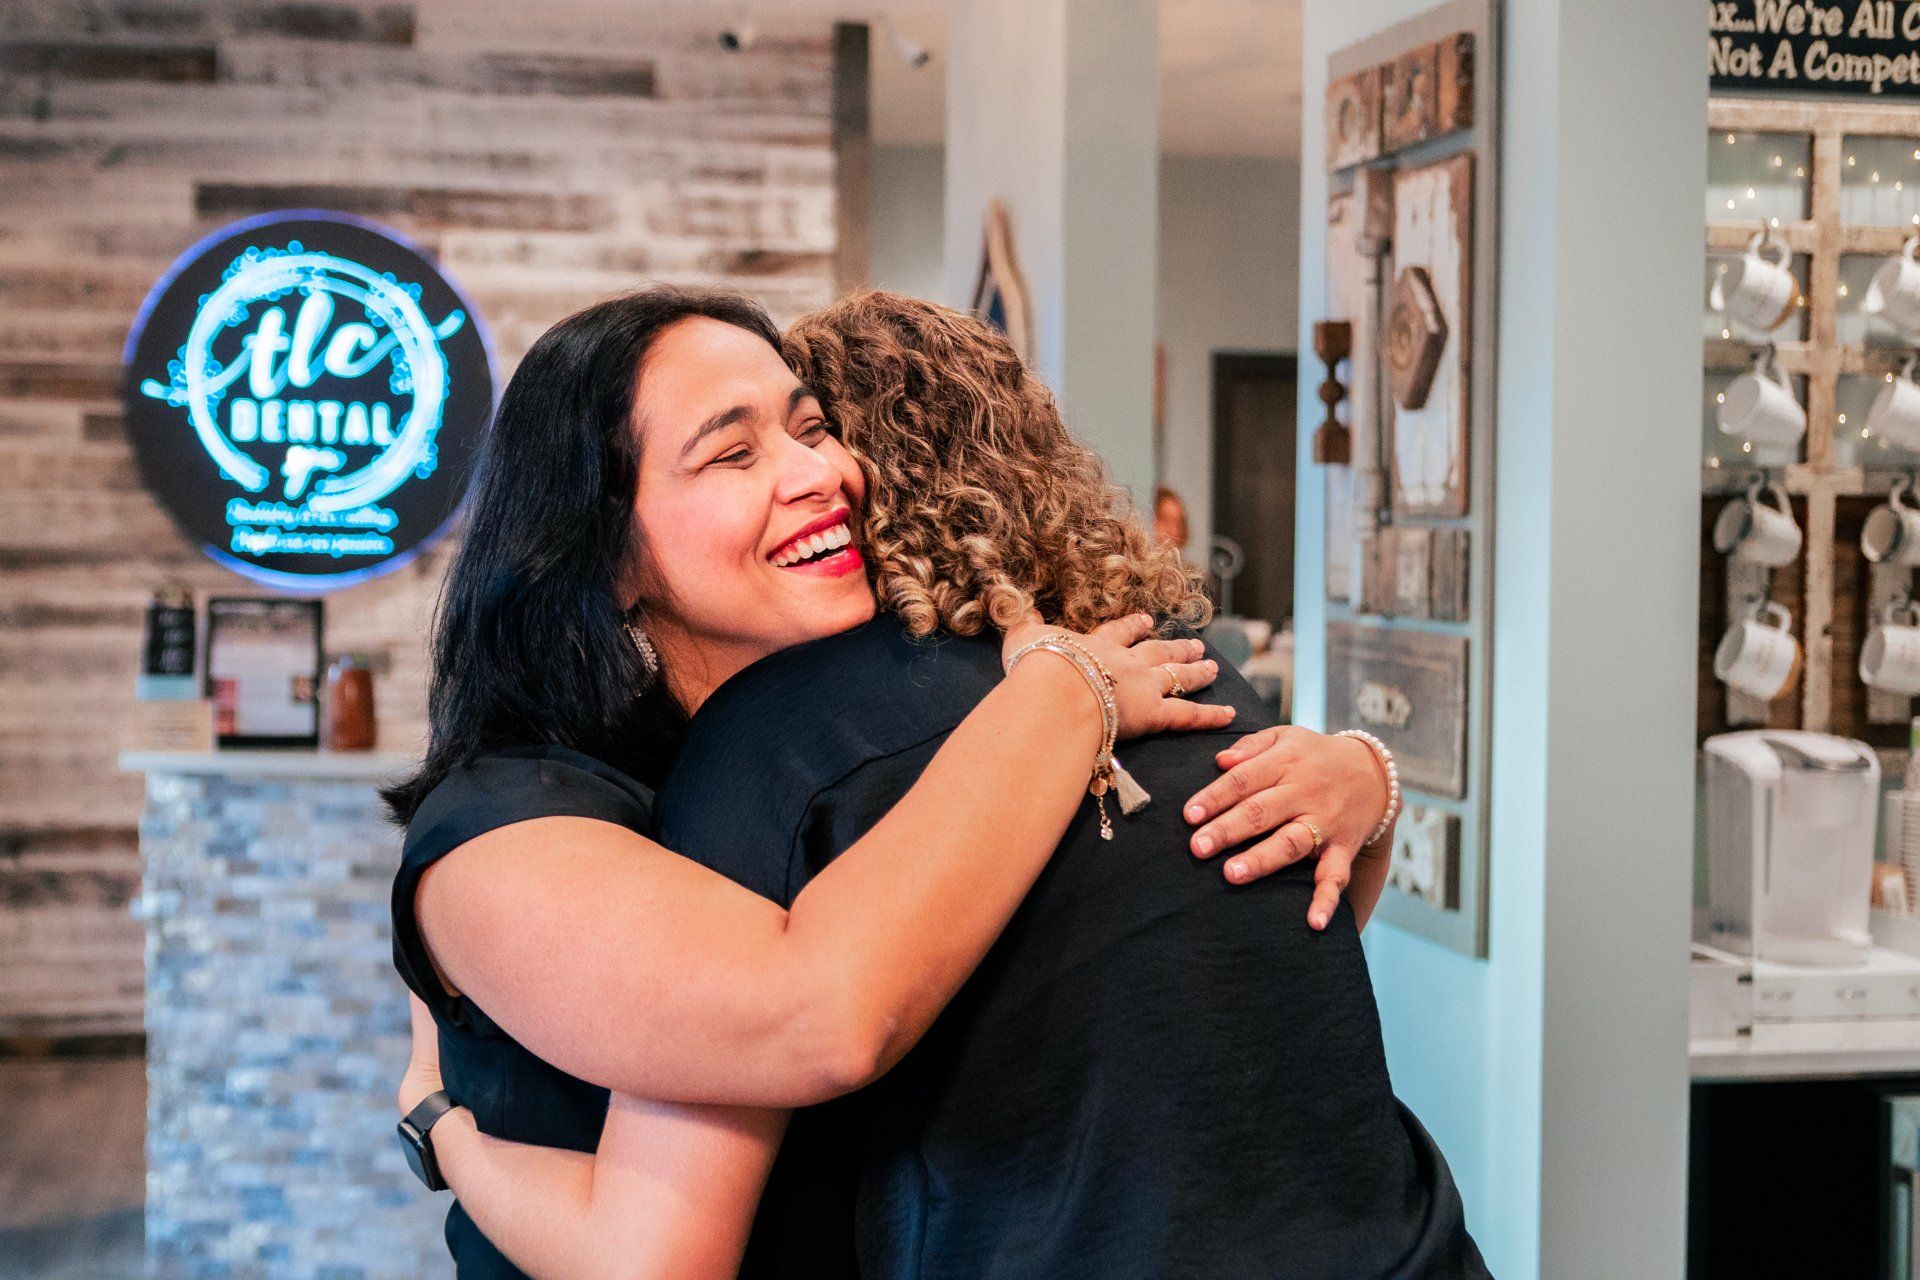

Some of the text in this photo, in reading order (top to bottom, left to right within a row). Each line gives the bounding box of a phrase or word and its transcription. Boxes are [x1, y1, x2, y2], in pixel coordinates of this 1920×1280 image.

[1848, 0, 1895, 39] All
[1708, 36, 1763, 77] Not
[1768, 38, 1797, 79] A
[240, 289, 379, 399] tlc
[230, 398, 394, 446] DENTAL
